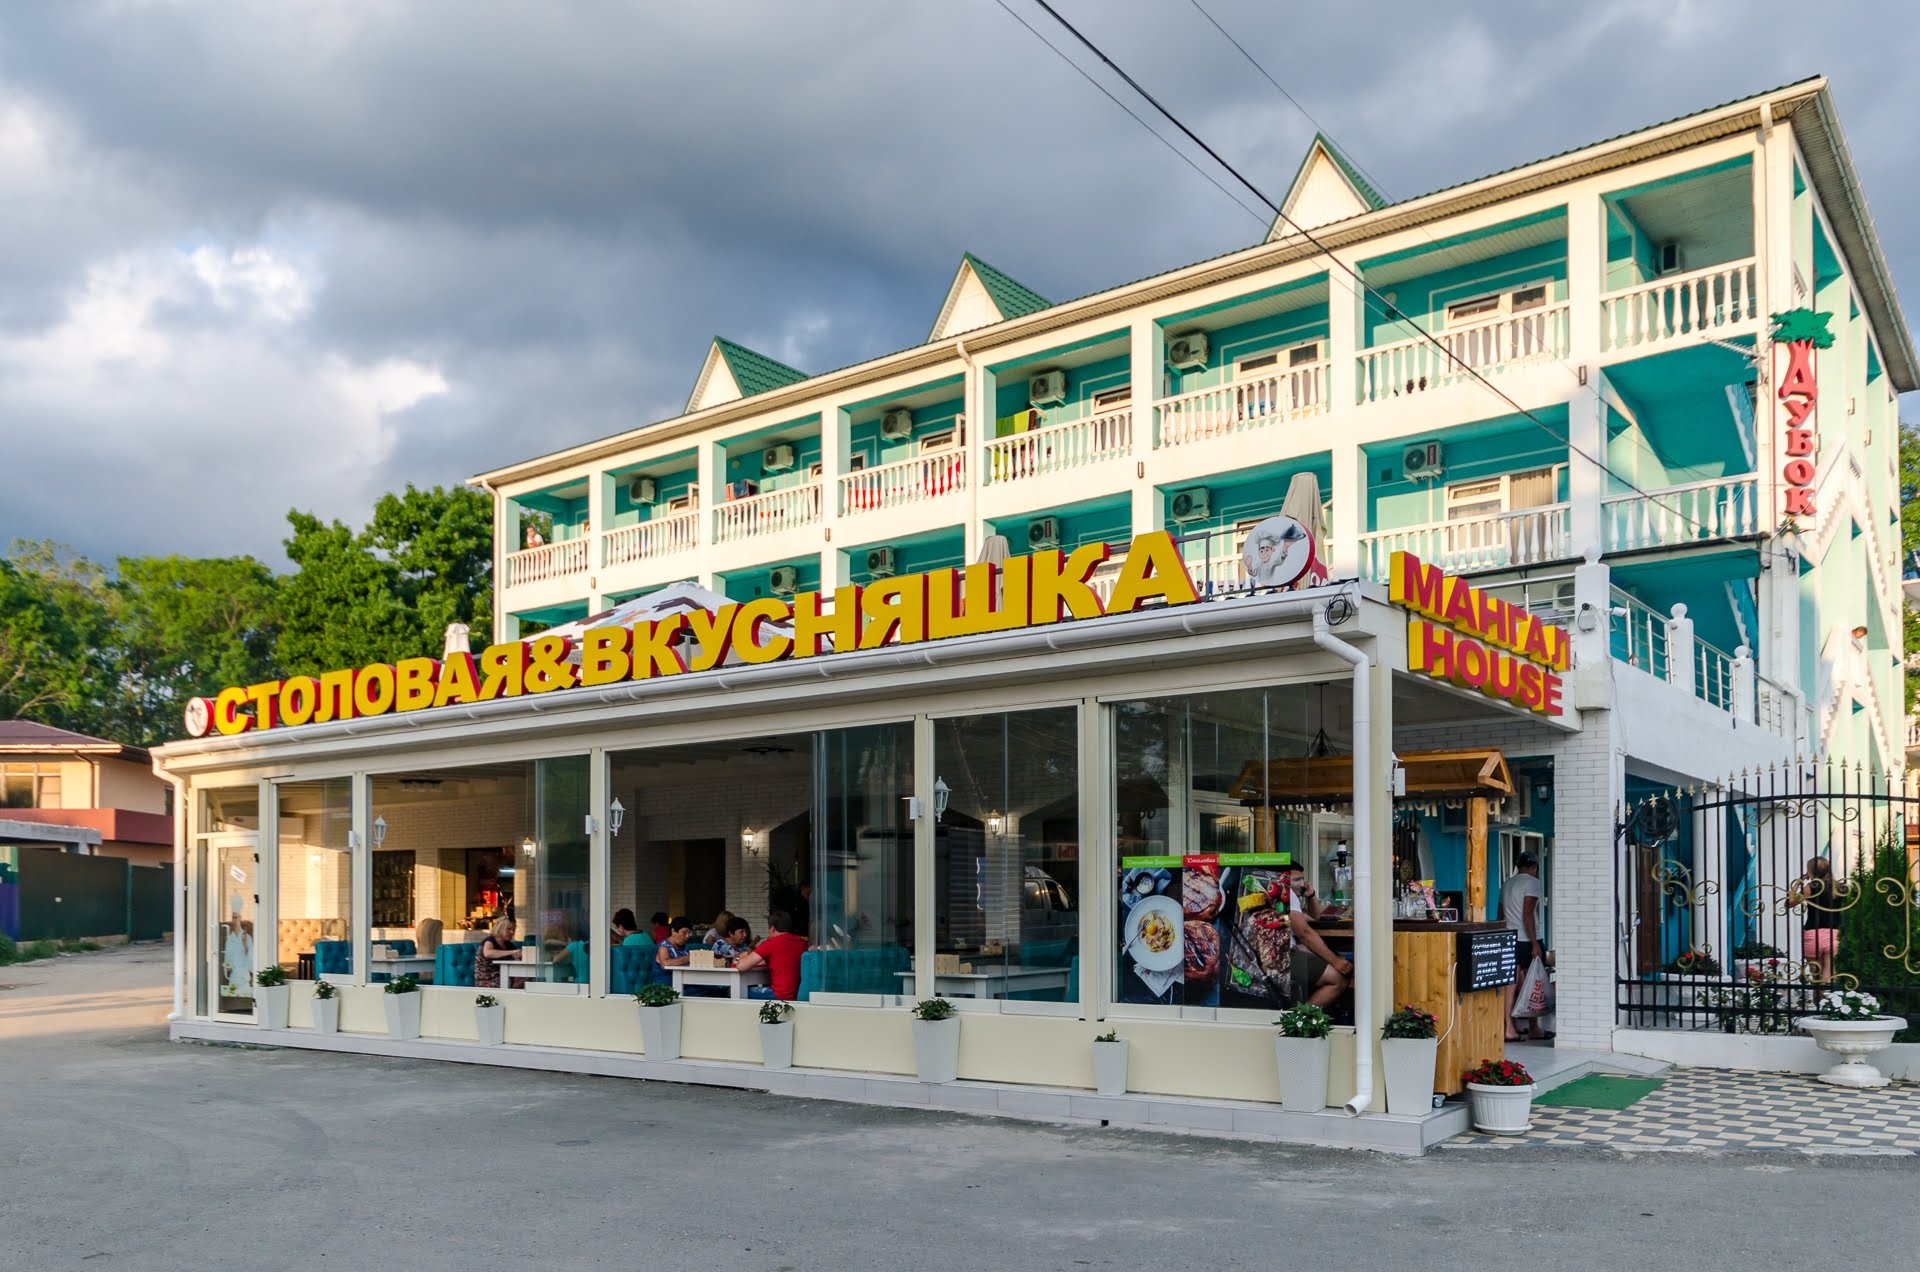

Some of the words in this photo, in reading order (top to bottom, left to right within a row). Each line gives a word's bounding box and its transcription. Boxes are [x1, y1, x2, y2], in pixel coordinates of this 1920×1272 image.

[1778, 339, 1818, 515] ДУБОК
[1389, 550, 1571, 672] МАНГАЛ
[1408, 620, 1563, 716] HOUSE
